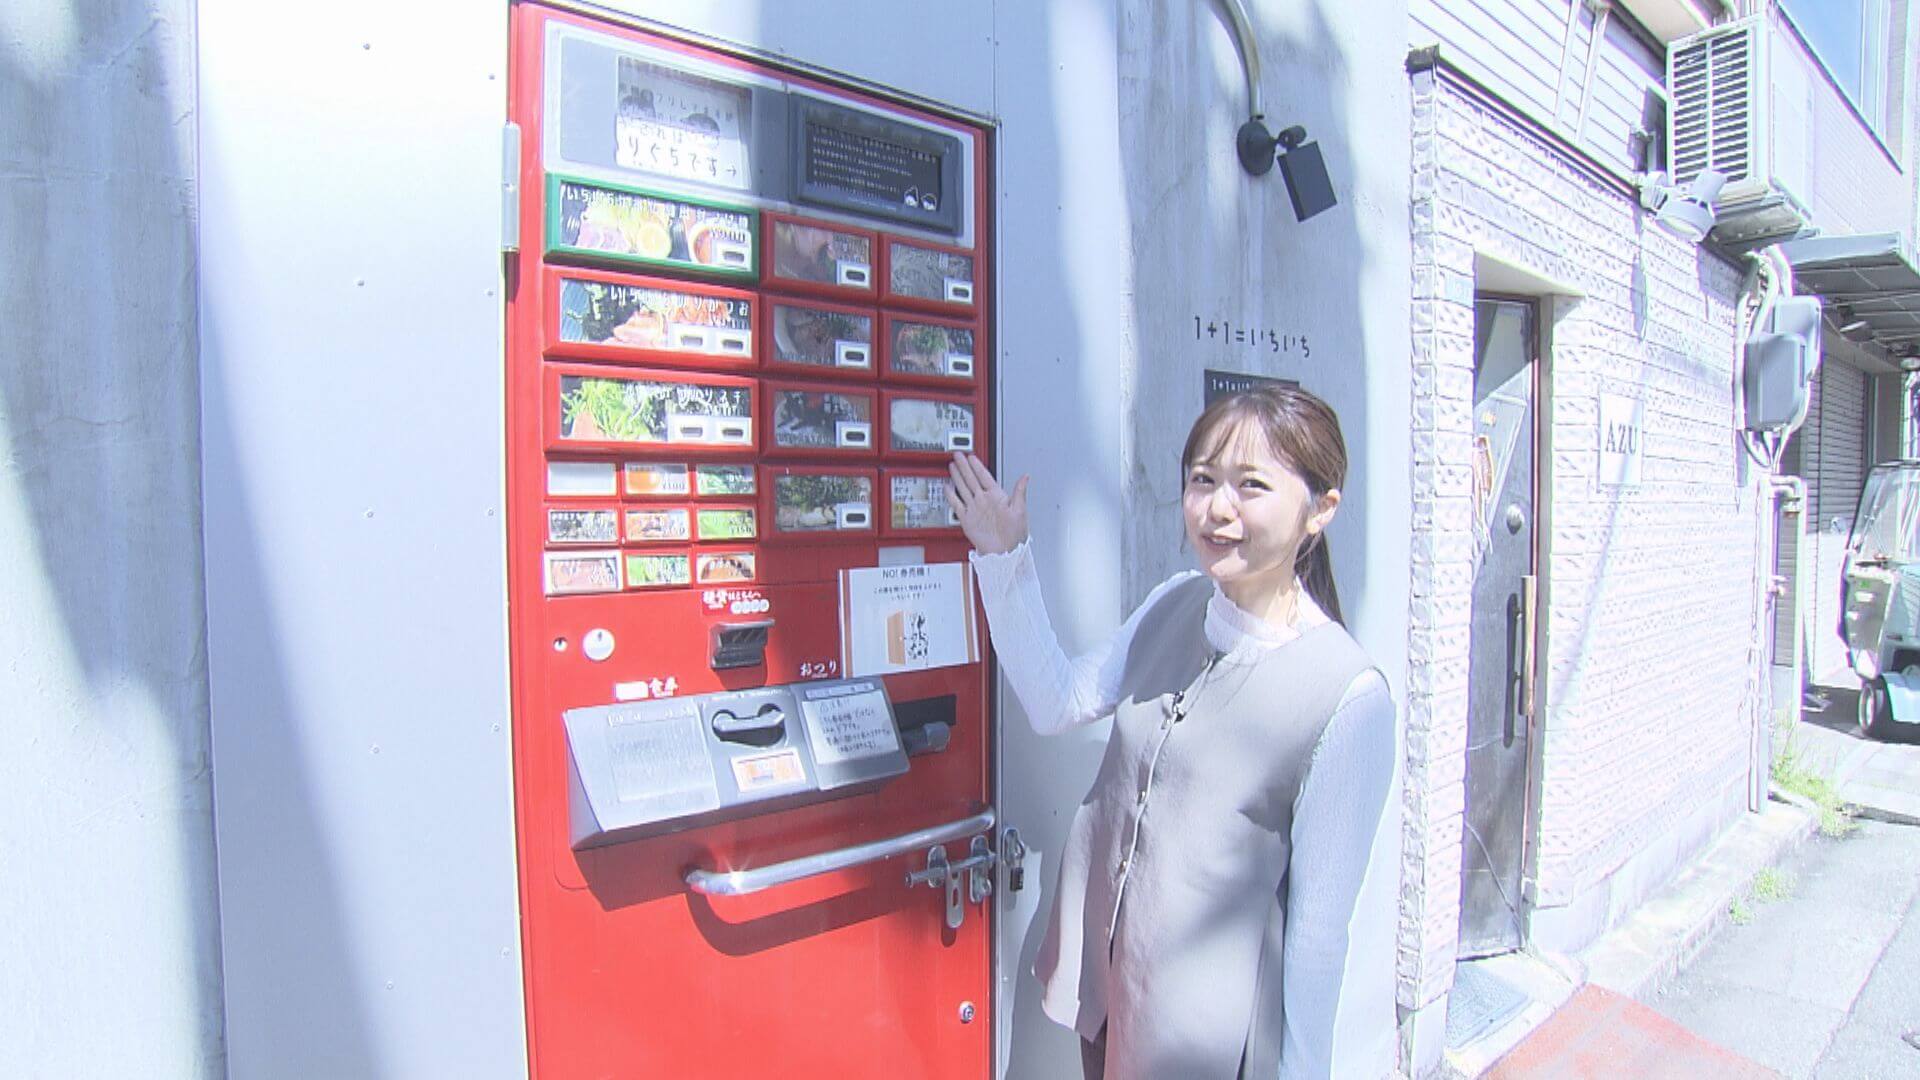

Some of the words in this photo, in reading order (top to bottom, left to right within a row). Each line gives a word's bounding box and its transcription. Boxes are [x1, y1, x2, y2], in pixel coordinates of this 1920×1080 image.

[1194, 315, 1310, 358] 1+1=いちいち
[1605, 420, 1638, 455] AZU
[800, 660, 837, 677] おつり
